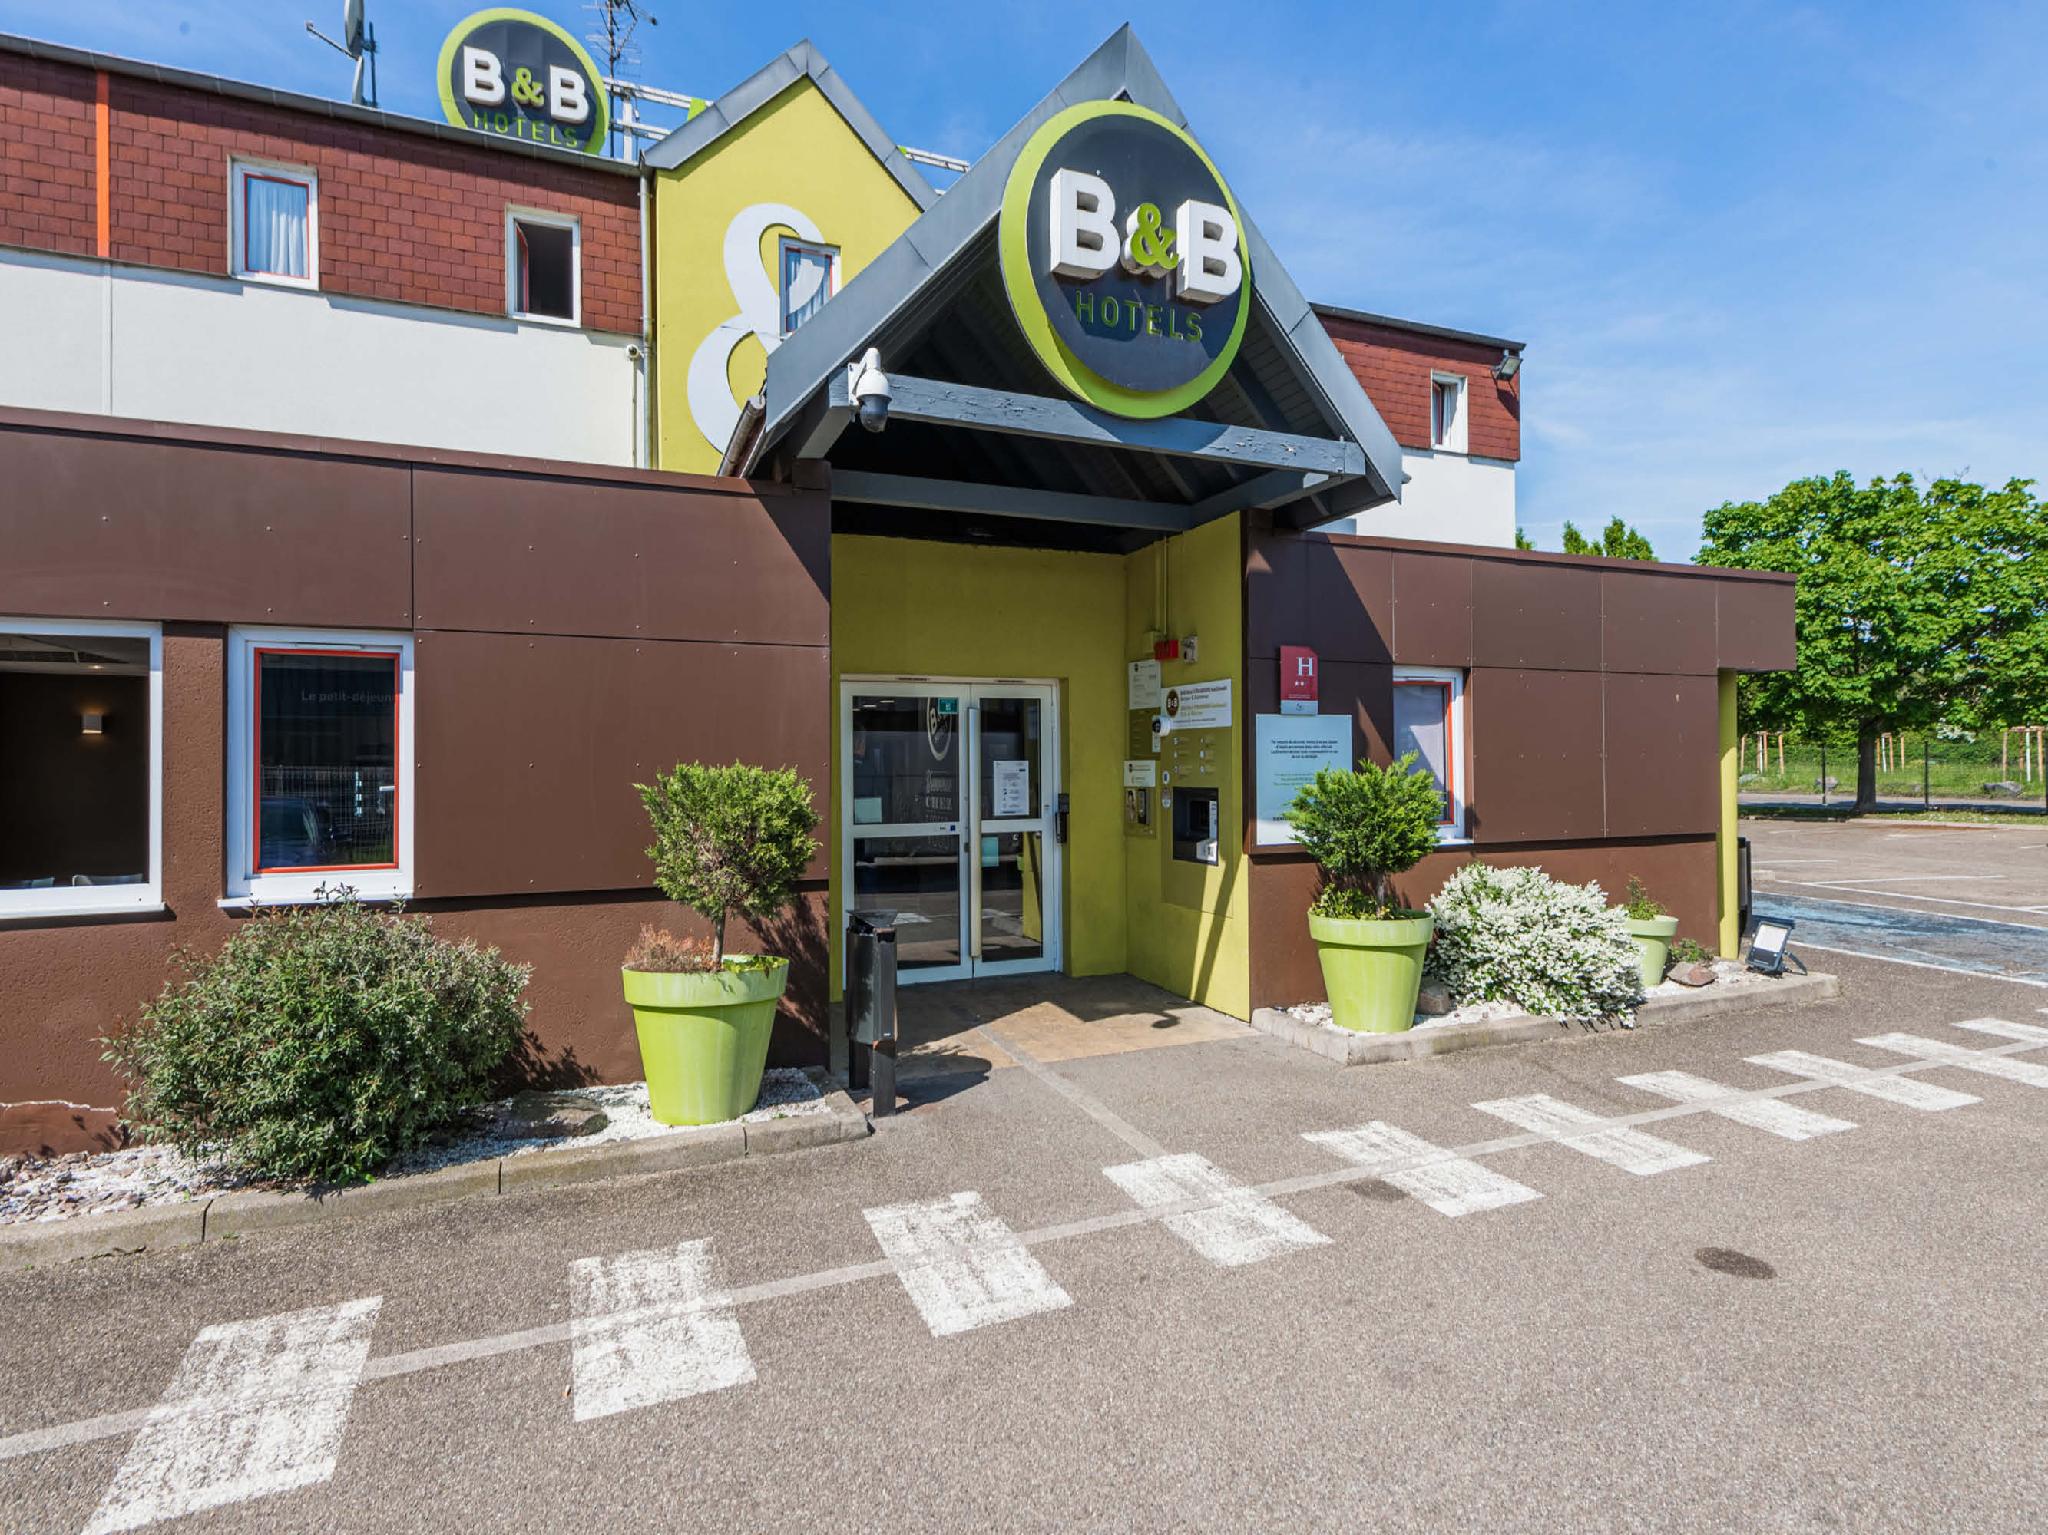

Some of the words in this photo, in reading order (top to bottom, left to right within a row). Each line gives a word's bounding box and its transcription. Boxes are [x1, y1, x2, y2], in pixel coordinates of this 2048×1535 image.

[463, 45, 589, 124] B&B
[473, 111, 578, 148] HOTELS
[1050, 168, 1243, 304] B&B
[1075, 288, 1204, 342] HOTELS
[1296, 656, 1314, 677] H
[301, 688, 317, 702] Le
[319, 687, 395, 705] petit-déjeun
